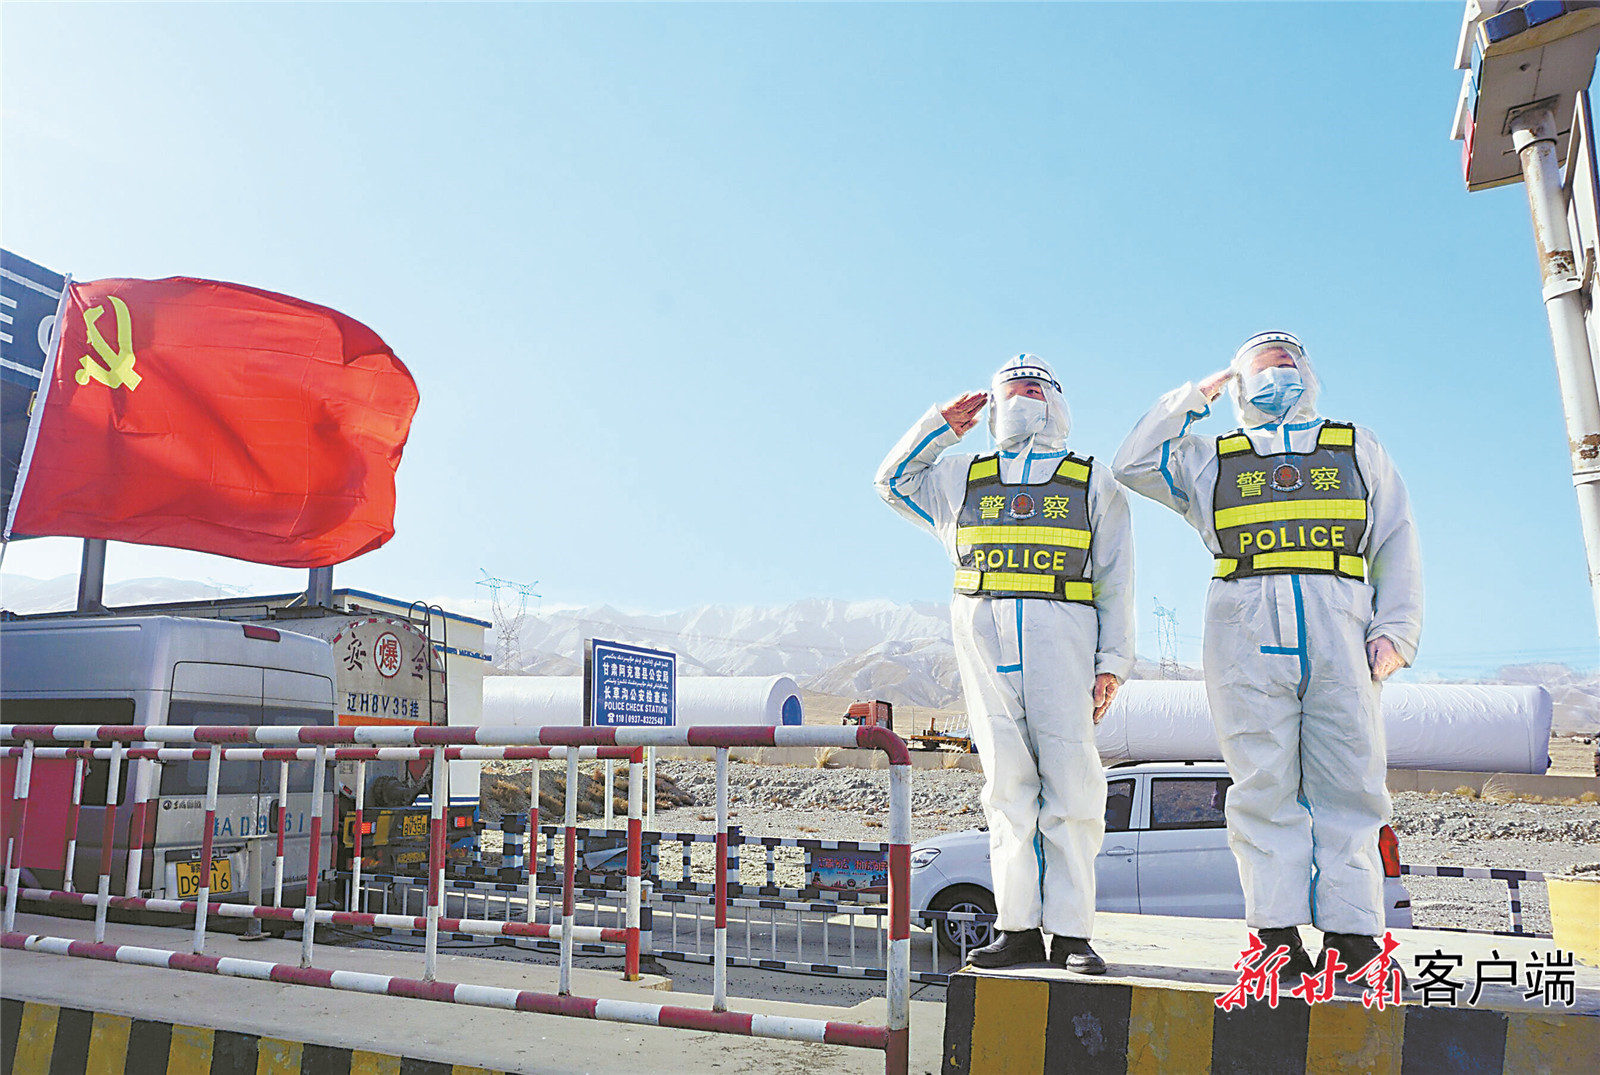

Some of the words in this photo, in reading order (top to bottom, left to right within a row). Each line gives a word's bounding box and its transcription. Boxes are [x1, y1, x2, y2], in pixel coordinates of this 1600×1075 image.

[1236, 470, 1266, 497] 警
[1310, 467, 1341, 491] 察
[979, 494, 1006, 519] 警
[1042, 494, 1070, 519] 察
[1240, 525, 1346, 554] POLICE
[974, 549, 1067, 571] POLICE
[378, 638, 399, 671] 爆
[602, 662, 668, 683] 甘肃阿克塞县公安局
[347, 691, 419, 718] 辽H8V35挂
[604, 686, 668, 704] 长草沟公安检查站
[604, 701, 625, 711] POLICE
[625, 702, 644, 712] CHECK
[644, 704, 668, 714] STATION
[180, 872, 229, 894] D916
